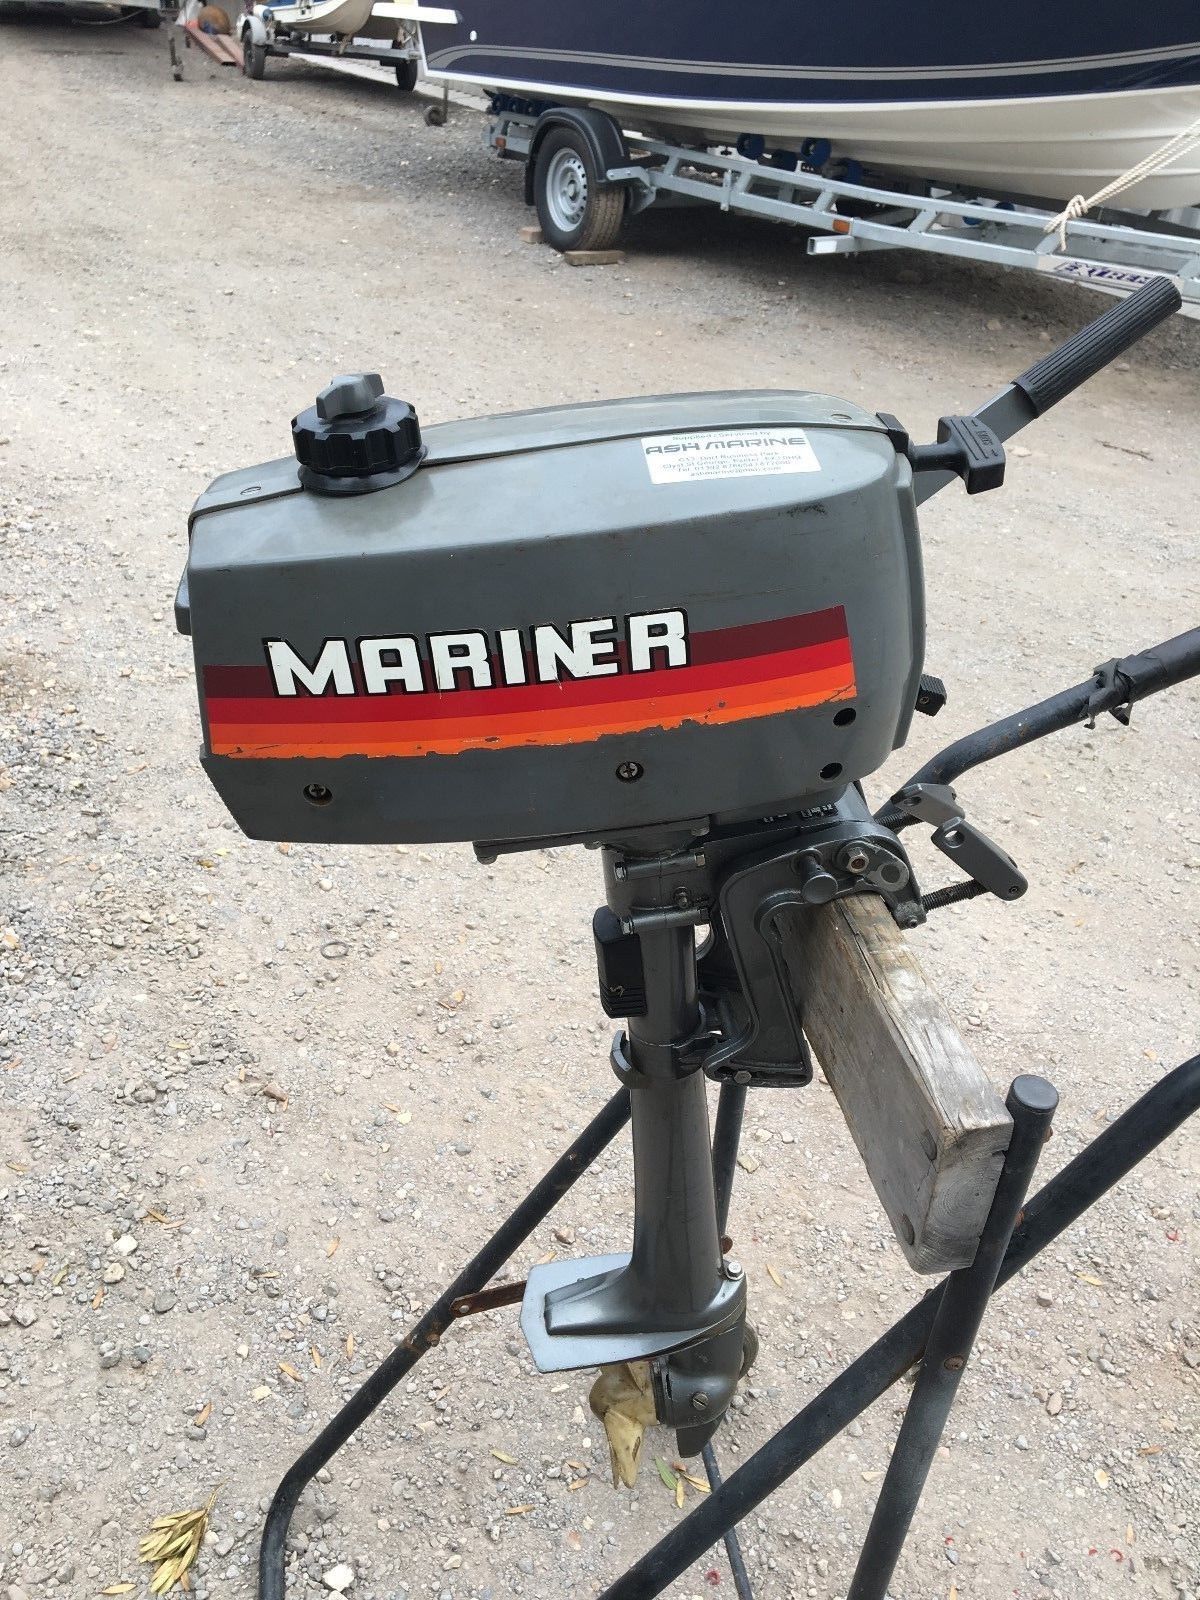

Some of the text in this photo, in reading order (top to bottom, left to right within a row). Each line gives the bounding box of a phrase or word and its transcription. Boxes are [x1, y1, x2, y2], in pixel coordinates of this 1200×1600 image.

[645, 437, 807, 455] ASH MARINE
[262, 607, 689, 698] MARINER
